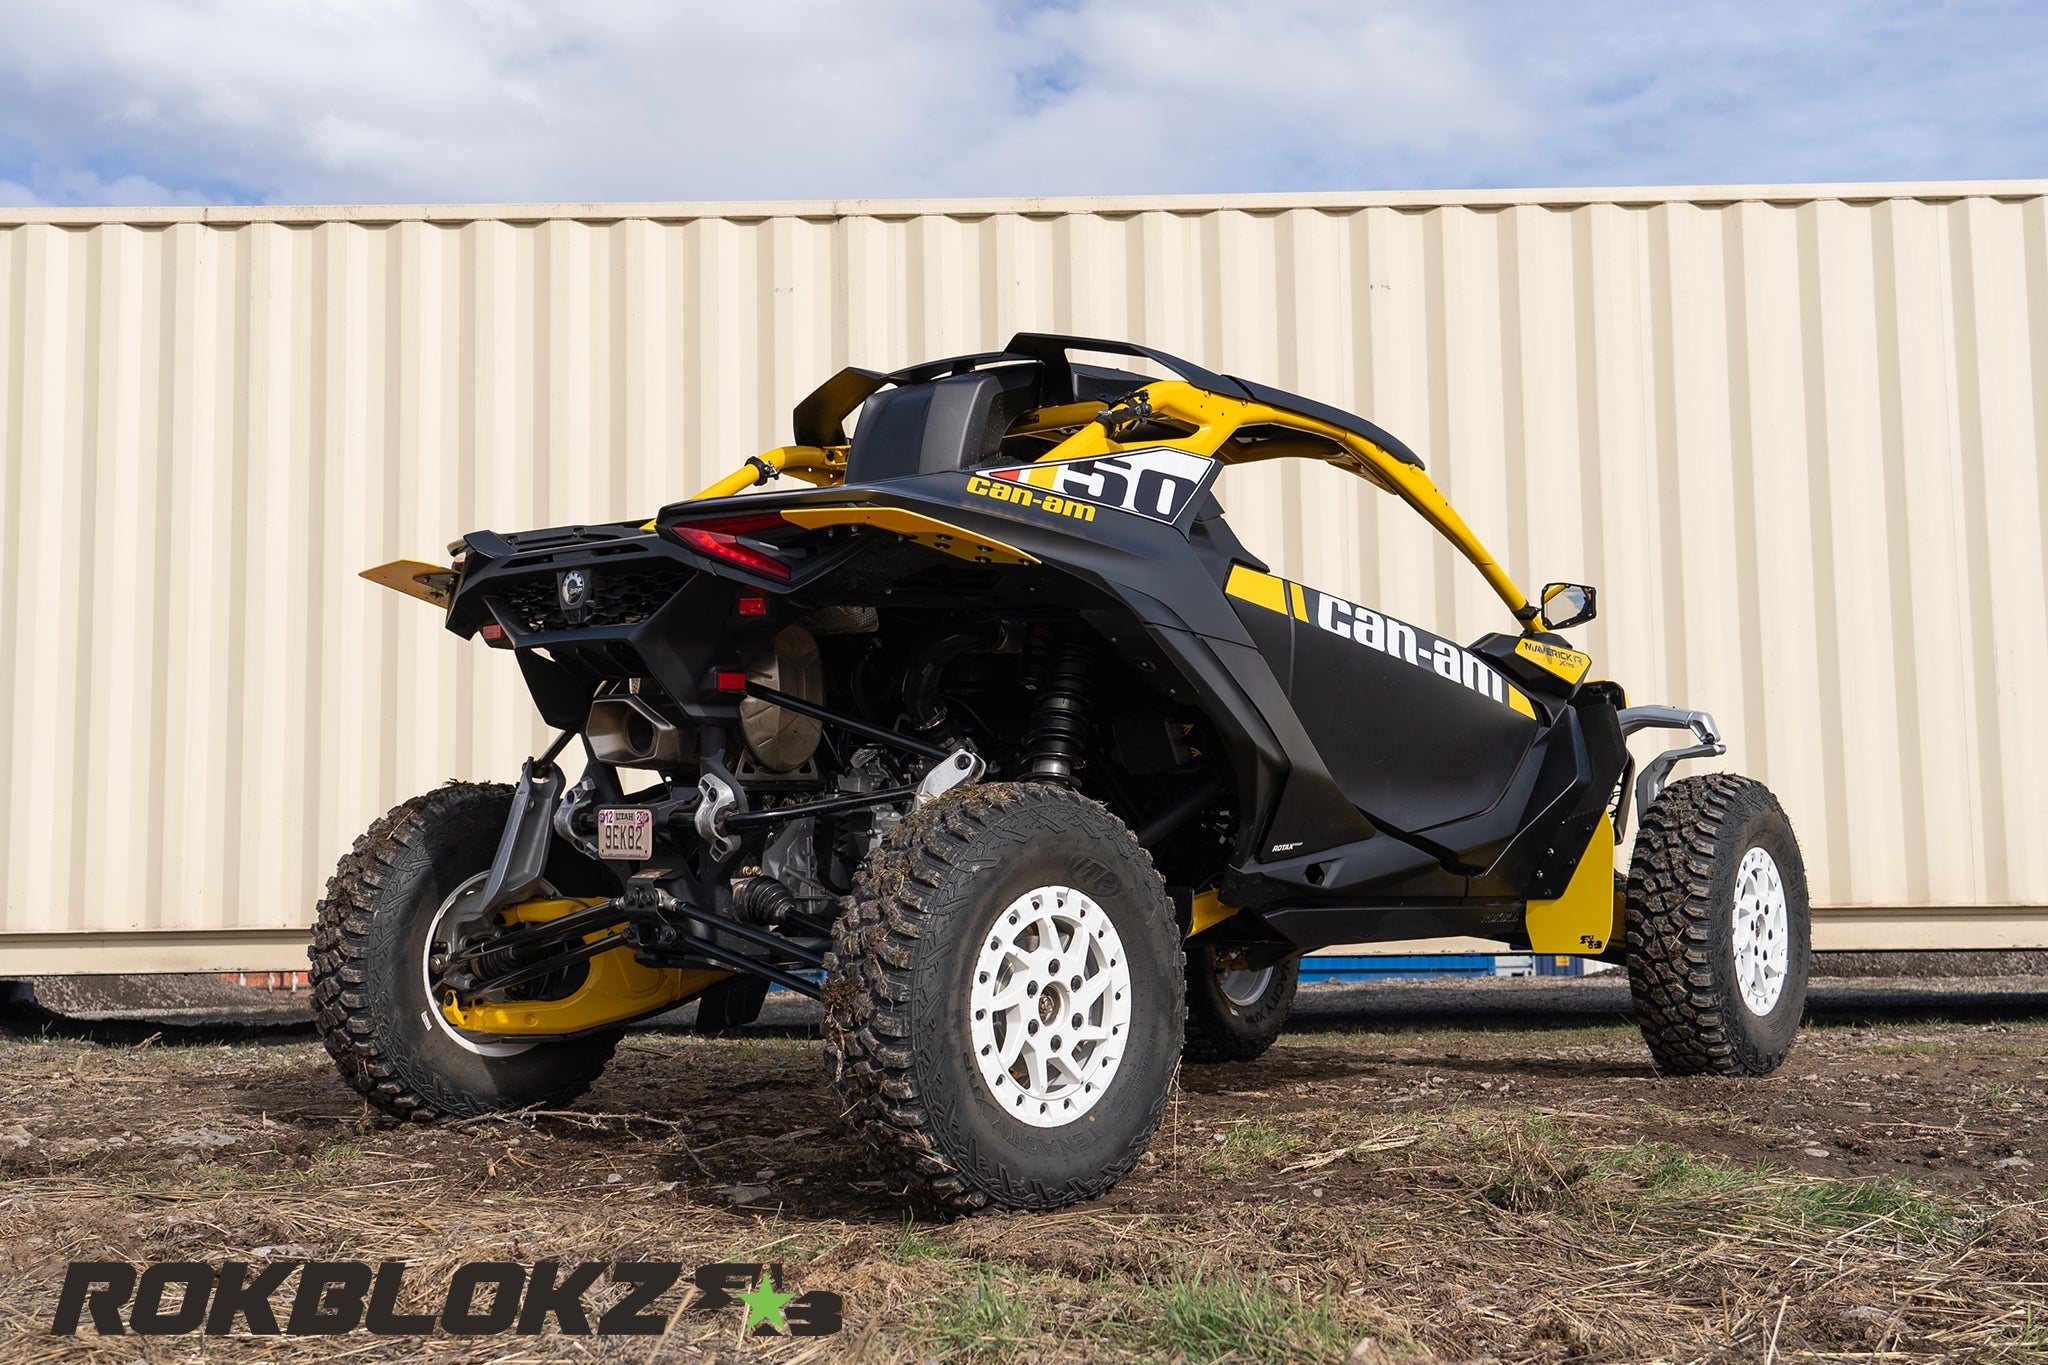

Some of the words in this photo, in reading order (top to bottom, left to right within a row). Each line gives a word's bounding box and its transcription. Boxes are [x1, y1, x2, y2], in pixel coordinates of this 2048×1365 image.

[966, 475, 1097, 523] can-am
[1317, 592, 1504, 704] can-am
[1524, 642, 1573, 662] MAVERICK
[615, 812, 634, 821] UTAH
[605, 824, 643, 850] 9EK82
[1073, 856, 1119, 891] ITP
